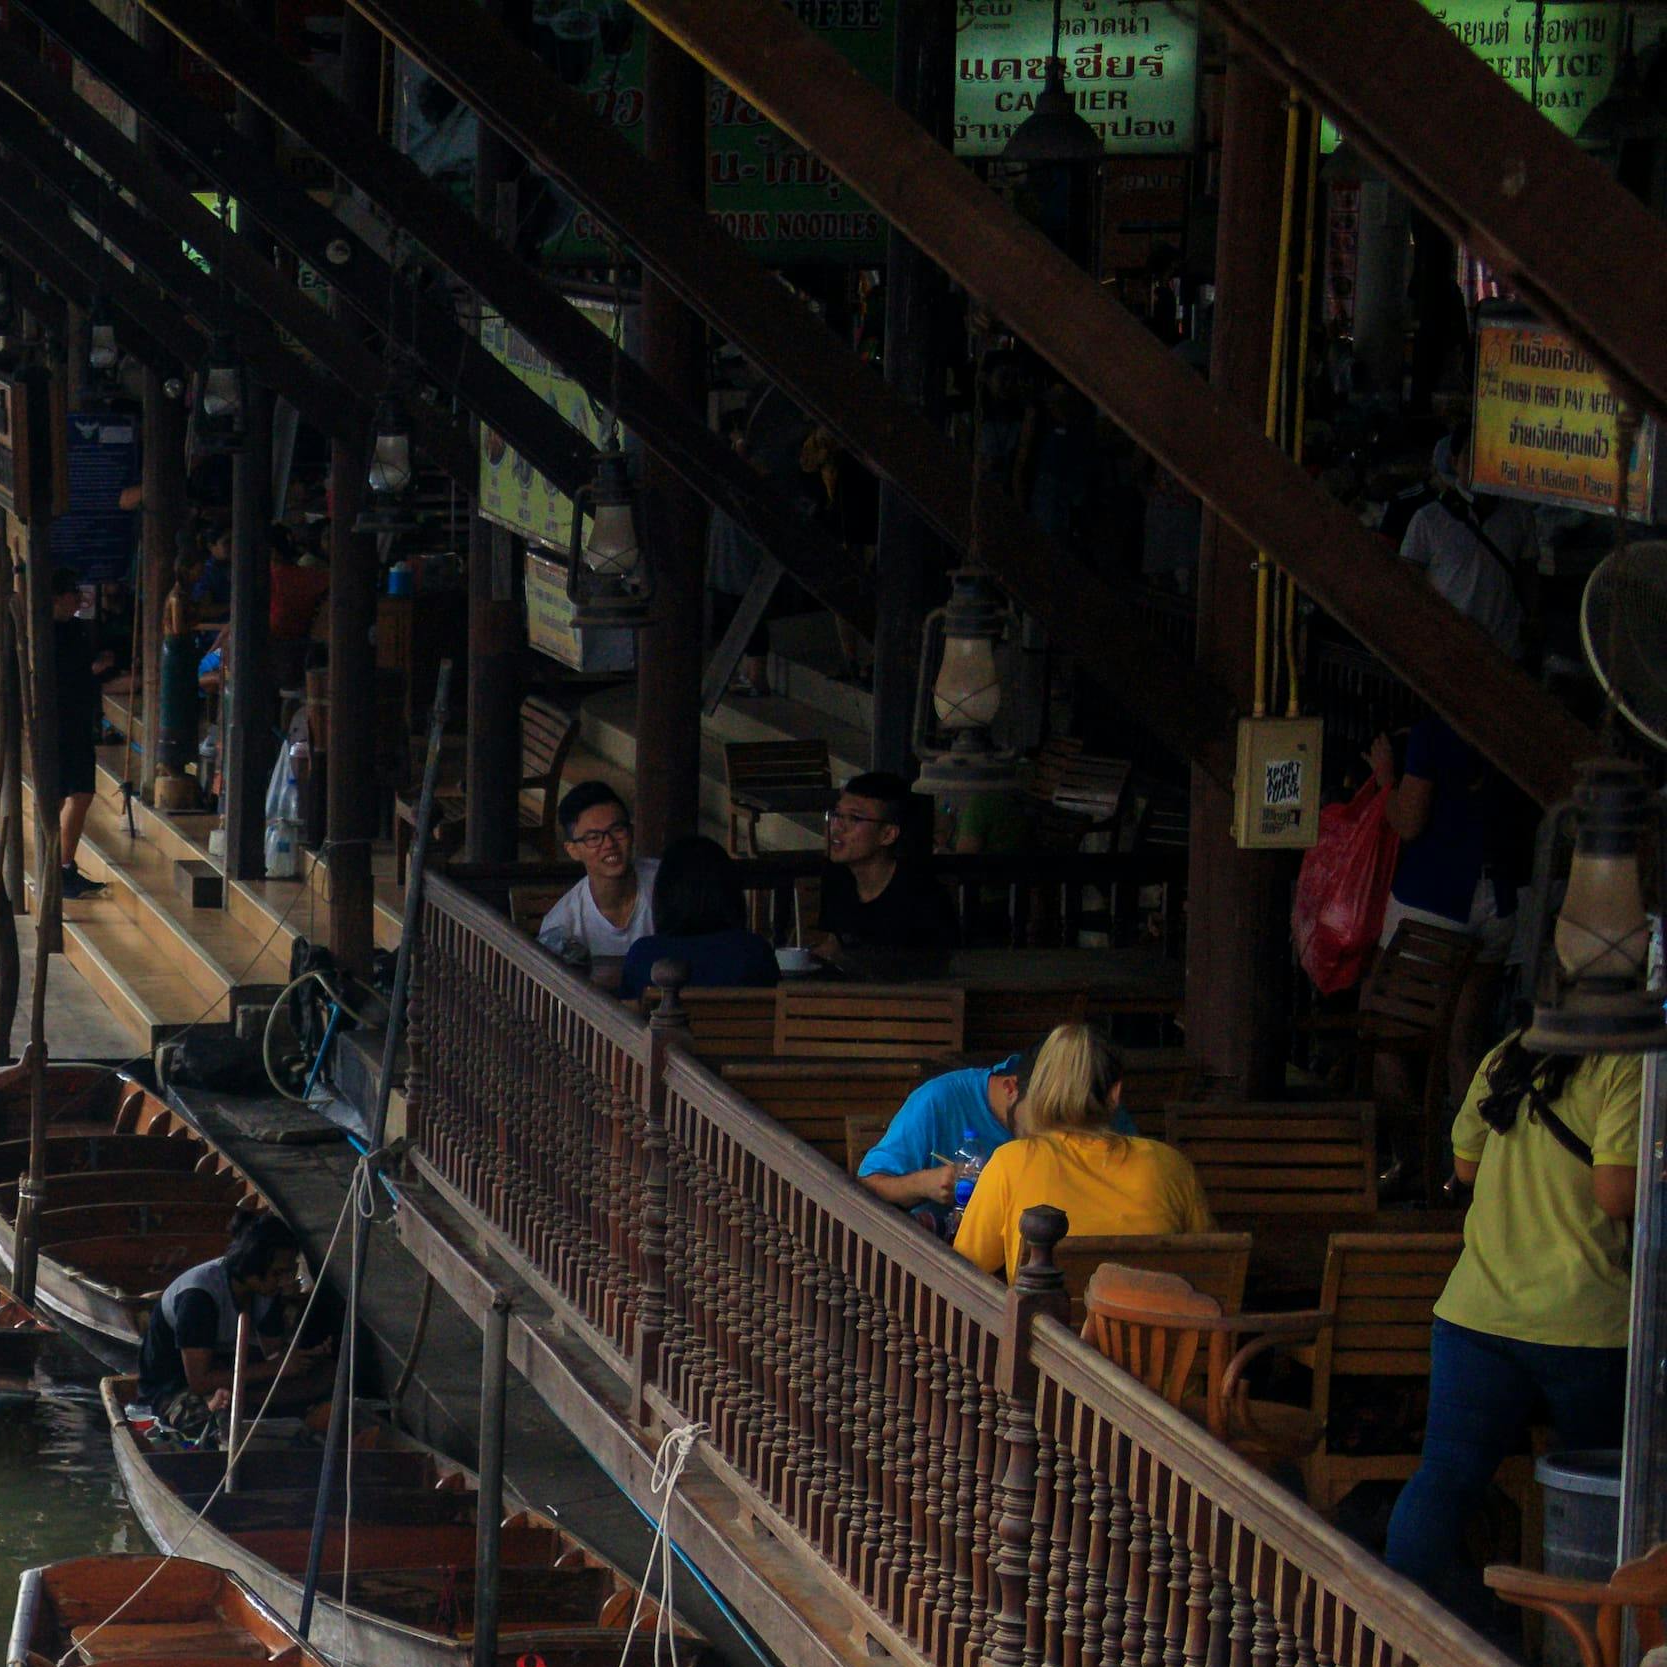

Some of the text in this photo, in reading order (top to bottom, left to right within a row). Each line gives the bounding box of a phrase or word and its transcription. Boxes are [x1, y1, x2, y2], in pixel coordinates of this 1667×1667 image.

[995, 91, 1128, 112] CAIER
[775, 212, 879, 241] NOODLES
[1502, 380, 1531, 404] FINISH
[1535, 383, 1562, 407] FIRST
[1564, 388, 1584, 412] PAY
